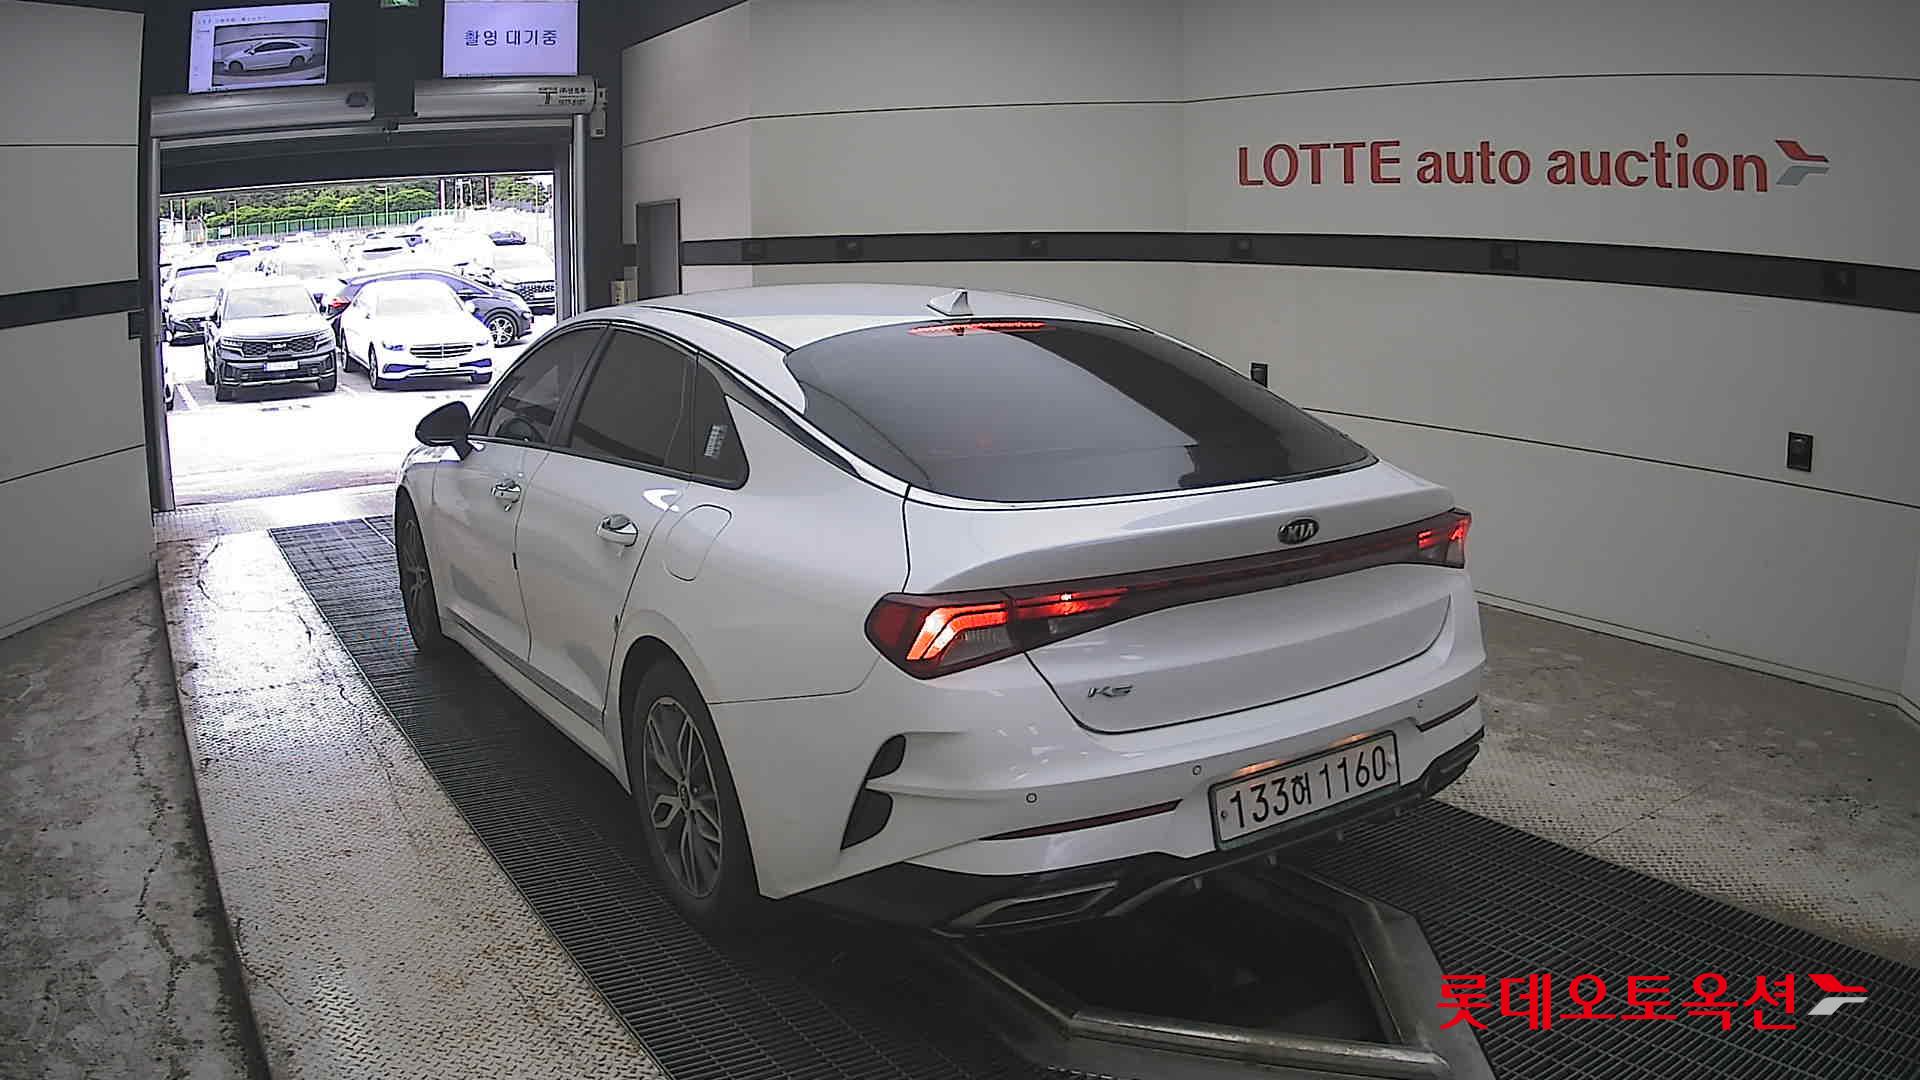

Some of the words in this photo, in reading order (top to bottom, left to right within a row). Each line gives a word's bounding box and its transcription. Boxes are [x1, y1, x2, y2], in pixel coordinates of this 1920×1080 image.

[505, 29, 558, 46] 대기중
[1238, 139, 1401, 187] LOTTE
[1416, 140, 1531, 186] auto
[1546, 133, 1769, 193] auction
[1087, 684, 1134, 698] K5
[1229, 771, 1312, 829] 133허
[1318, 745, 1388, 800] 1160
